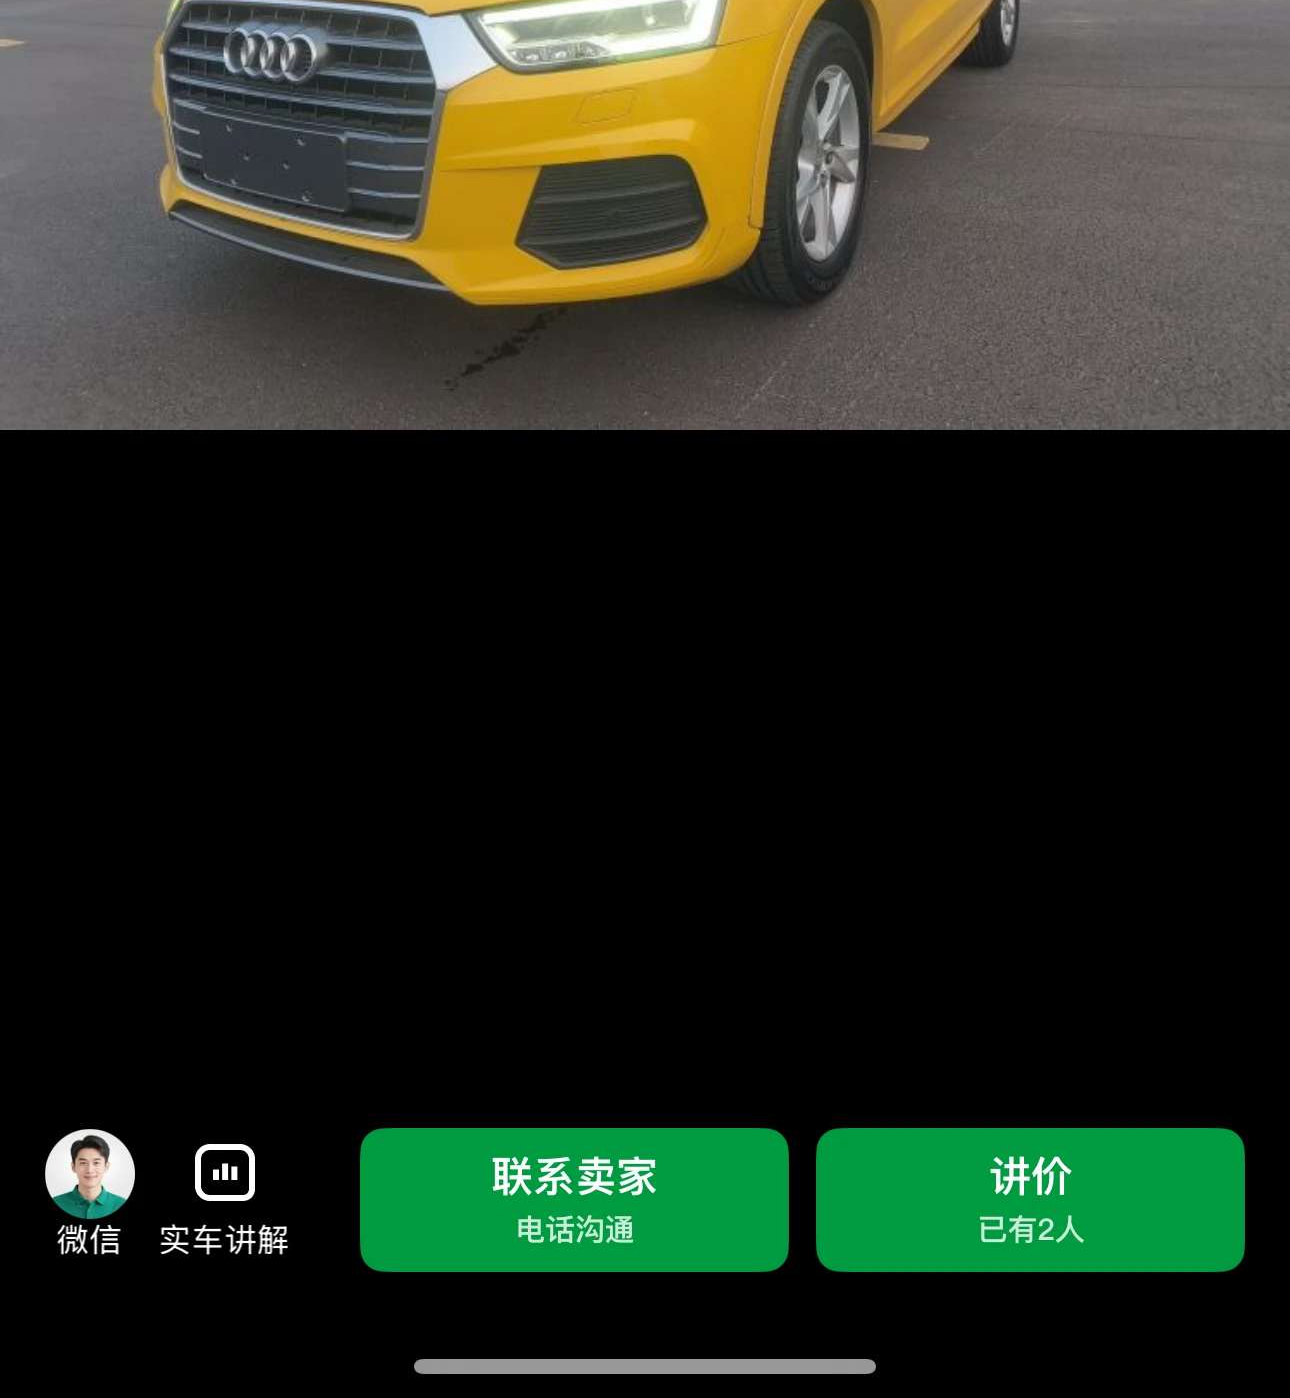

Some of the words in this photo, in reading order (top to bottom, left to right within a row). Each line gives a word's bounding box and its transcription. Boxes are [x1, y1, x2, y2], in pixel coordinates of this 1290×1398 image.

[492, 1155, 657, 1197] 联系卖家
[990, 1155, 1072, 1197] 讲价
[57, 1223, 121, 1255] 微信
[159, 1223, 289, 1255] 实车讲解
[516, 1214, 635, 1244] 电话沟通
[979, 1214, 1085, 1244] 已有2人
